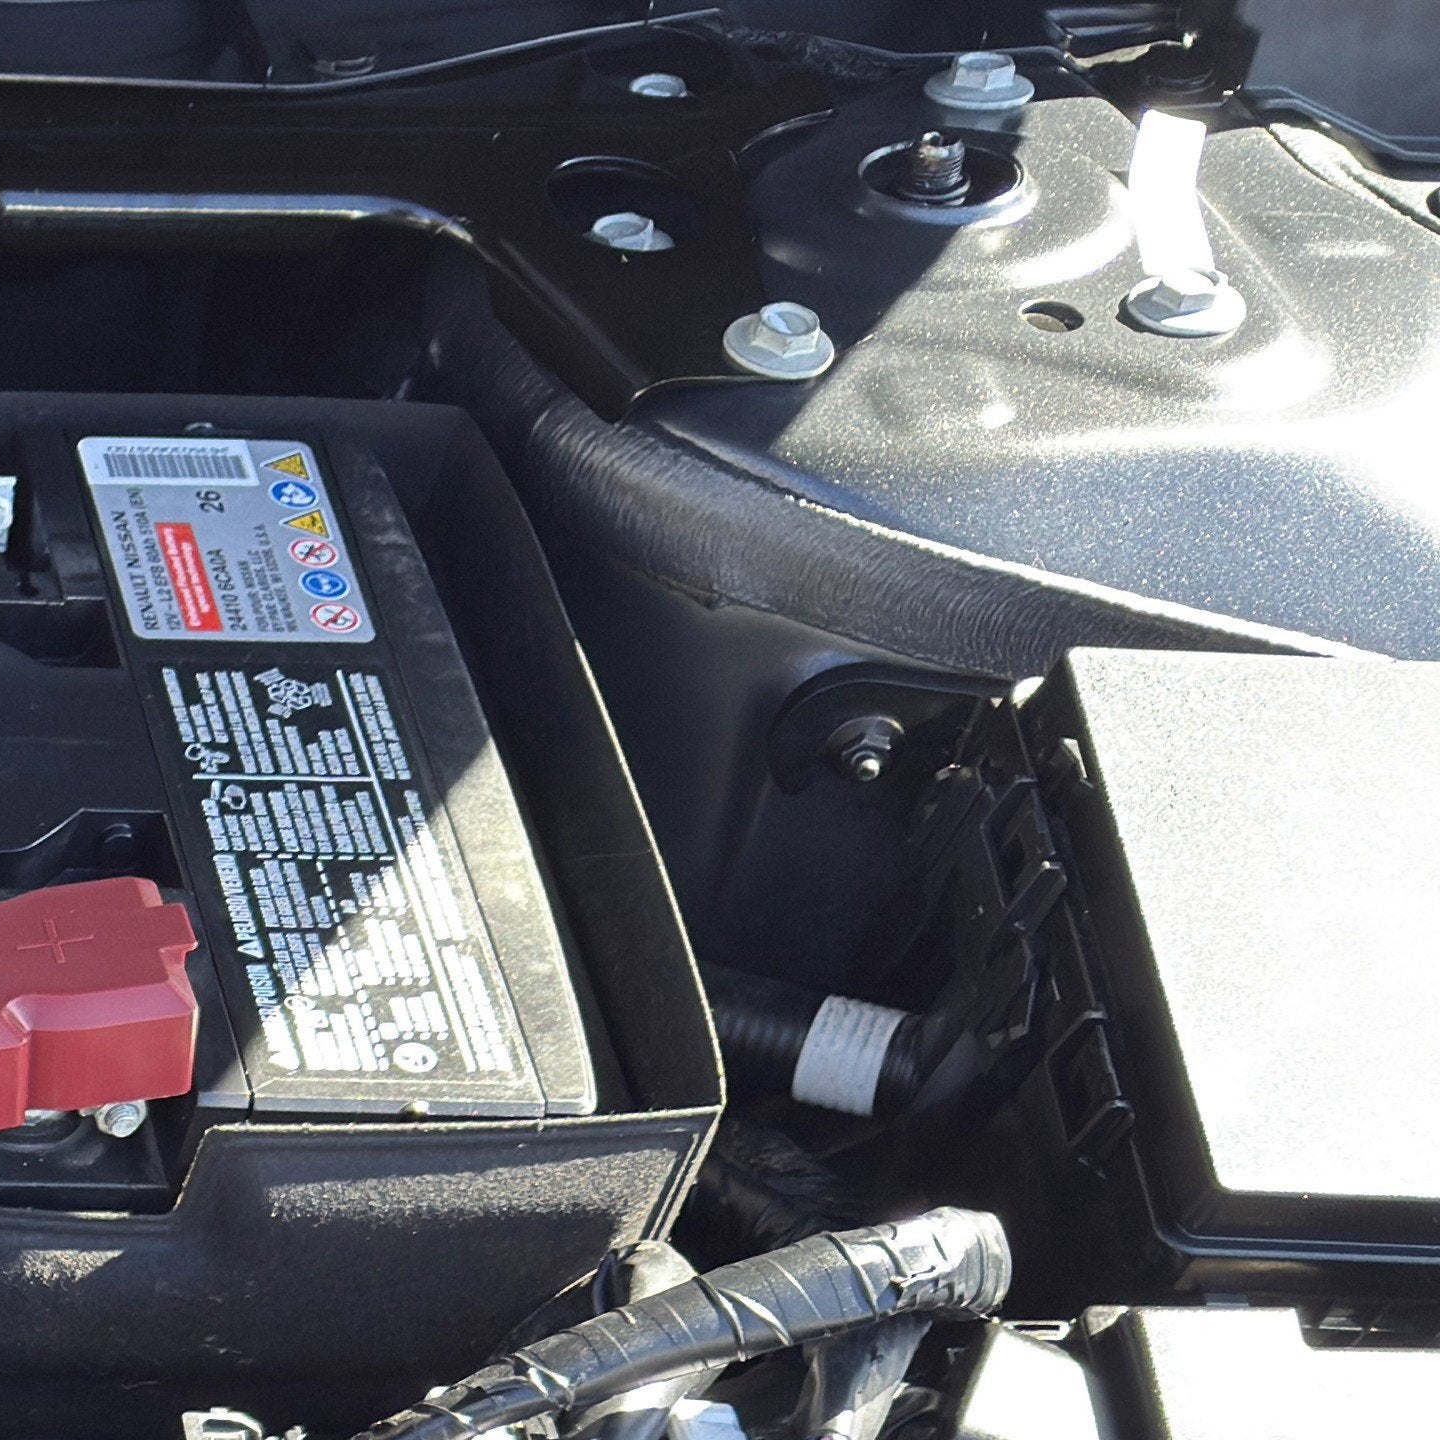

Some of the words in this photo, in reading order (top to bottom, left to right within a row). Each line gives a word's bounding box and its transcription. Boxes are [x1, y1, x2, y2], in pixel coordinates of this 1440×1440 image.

[195, 491, 224, 513] 26
[111, 511, 141, 568] NISSAN
[129, 573, 160, 630] RENAULT
[221, 594, 248, 631] 24410
